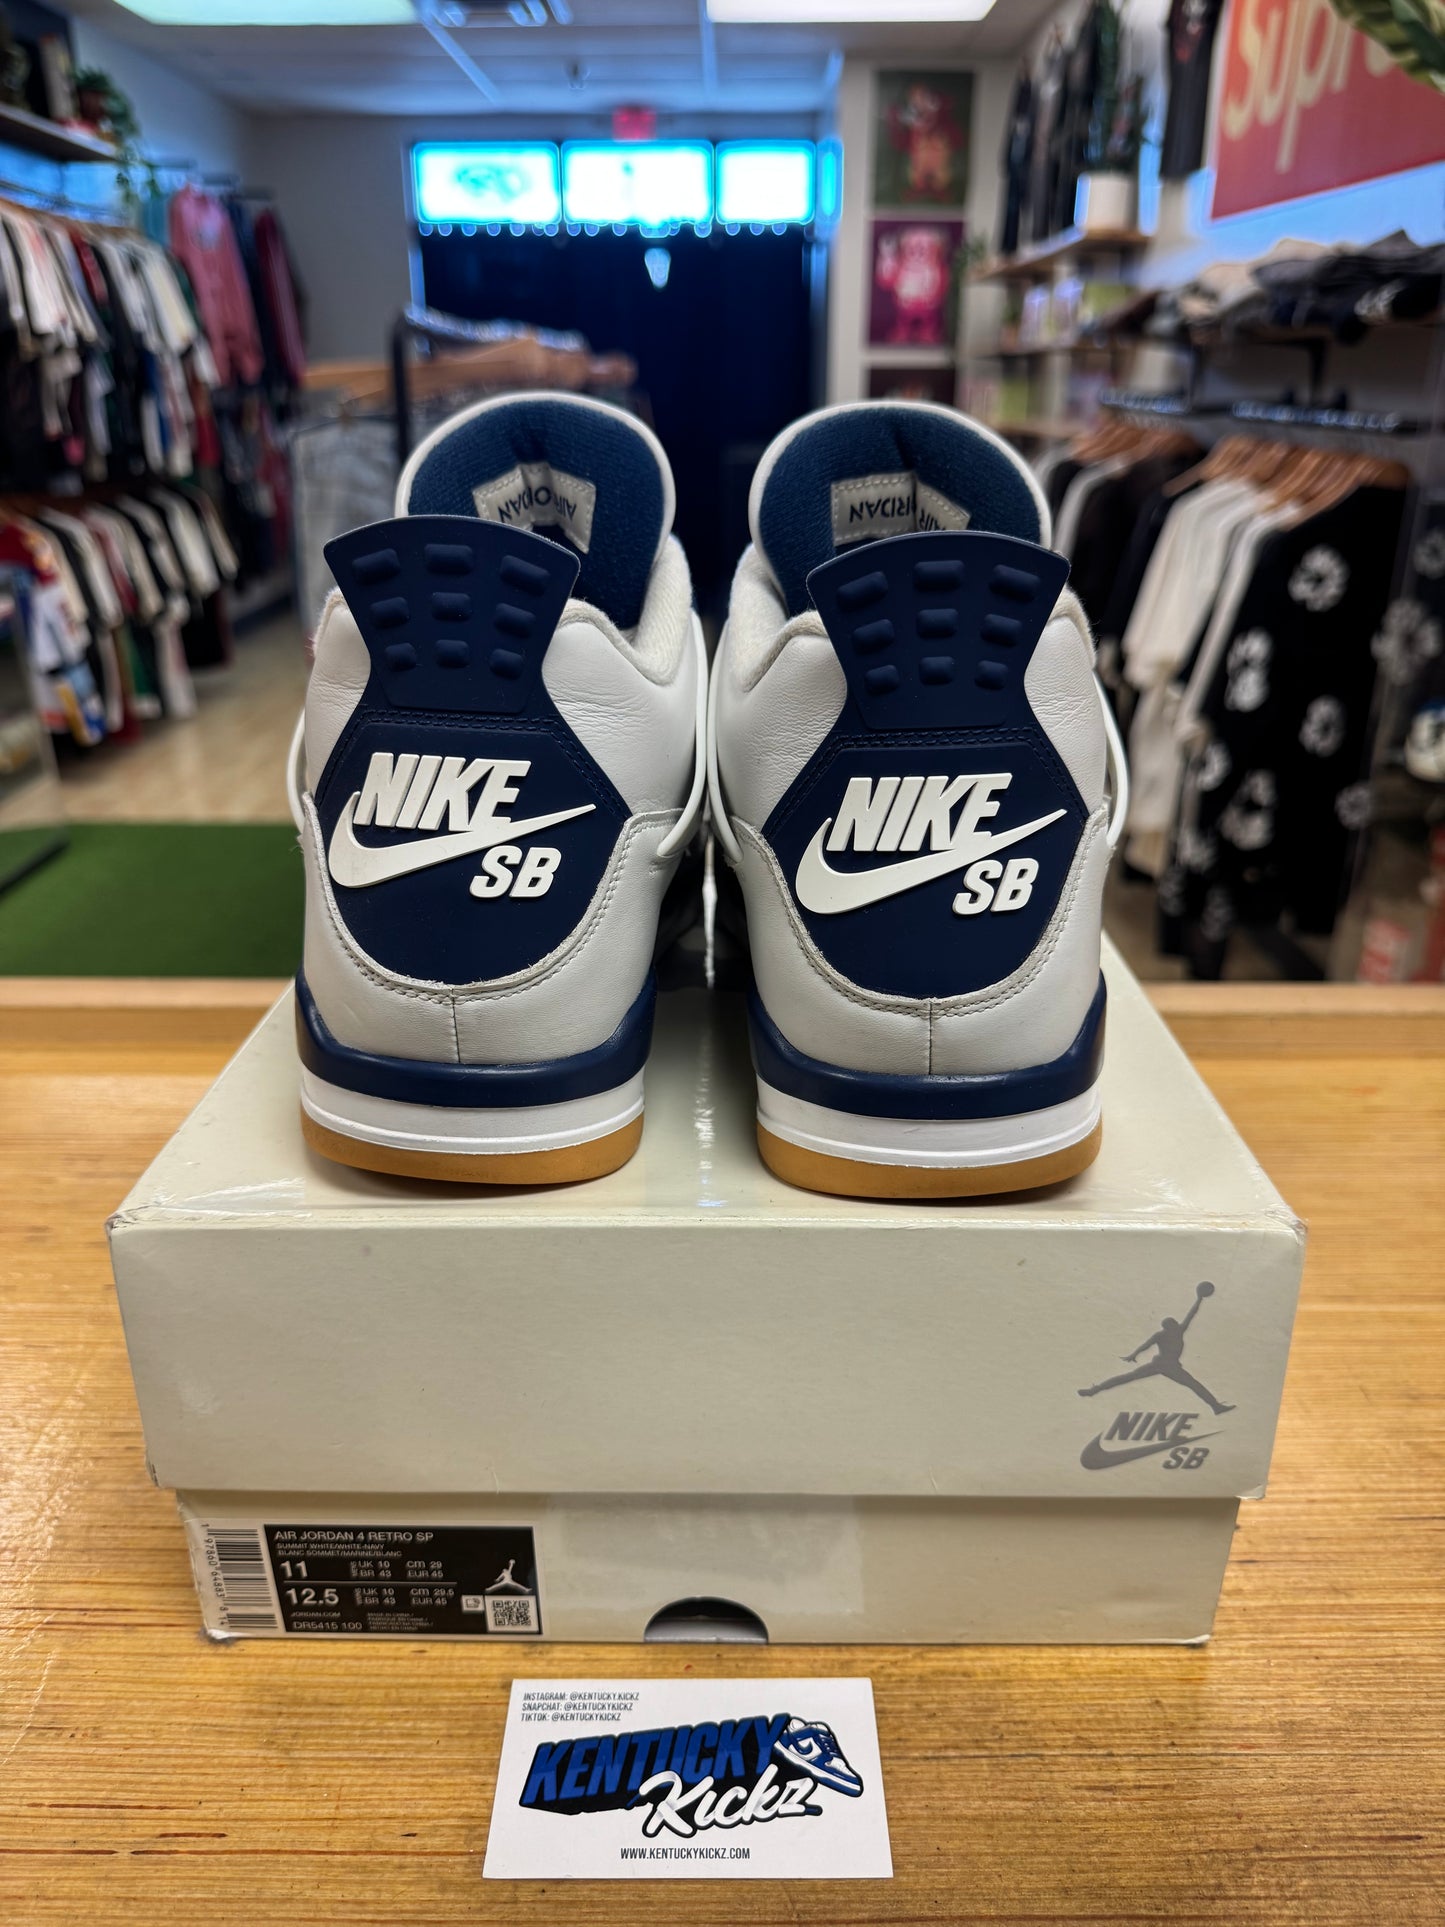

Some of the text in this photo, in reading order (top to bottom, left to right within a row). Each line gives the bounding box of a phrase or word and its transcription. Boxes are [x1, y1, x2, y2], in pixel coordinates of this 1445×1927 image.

[353, 752, 532, 831] NIKE
[826, 773, 1012, 851] NIKE
[469, 845, 562, 898] SB
[952, 858, 1039, 915] SB
[1103, 1412, 1199, 1441] NIKE
[1162, 1447, 1210, 1470] SB
[275, 1531, 434, 1541] AIR JORDAN 4 RETRO SP
[280, 1560, 308, 1578] 11
[359, 1560, 374, 1569] UK
[378, 1560, 390, 1569] 10
[430, 1560, 443, 1569] 29
[379, 1569, 392, 1578] 43
[407, 1569, 444, 1578] EUR 45
[362, 1587, 395, 1596] UK 10
[433, 1588, 455, 1597] 29.5
[285, 1588, 340, 1606] 12.5
[412, 1597, 447, 1605] EUR 45
[293, 1621, 339, 1630] DR5415
[341, 1622, 363, 1630] 100
[523, 1692, 568, 1701] INSTAGRAM:
[522, 1702, 633, 1711] SNAPCHAT: @KENTUCKYKICKZ
[520, 1712, 622, 1721] TIKTOK: @KENTUCKYKICKZ
[521, 1713, 791, 1808] KENTUCKY
[638, 1763, 817, 1838] Kickz
[620, 1847, 751, 1860] WWW.KENTUCKYKICKZ.COM
